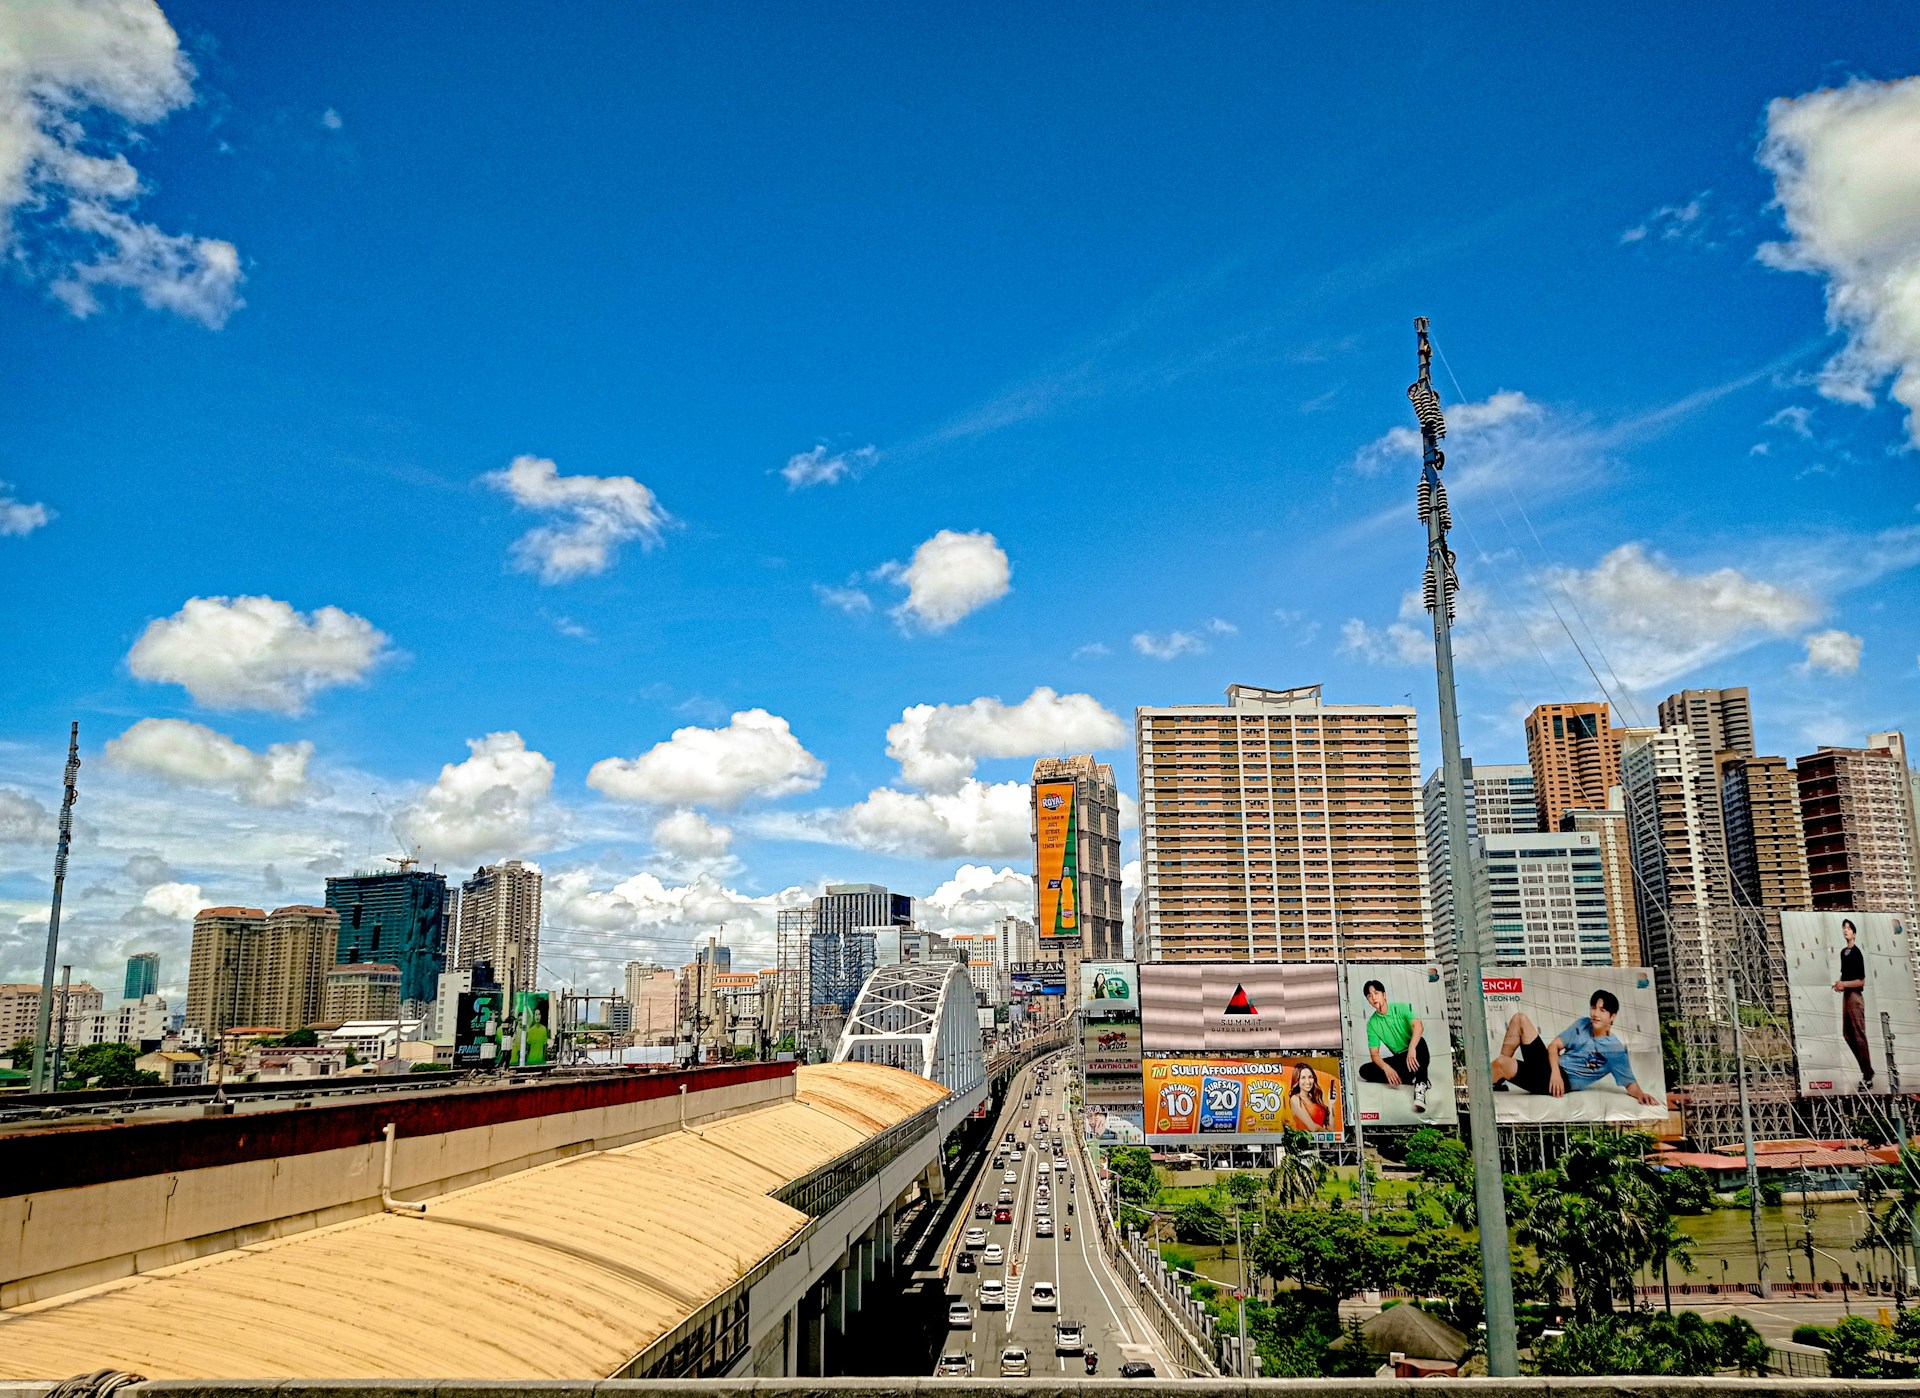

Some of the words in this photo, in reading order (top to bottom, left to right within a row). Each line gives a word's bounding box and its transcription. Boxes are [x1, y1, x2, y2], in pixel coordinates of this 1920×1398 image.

[1042, 796, 1064, 808] ROYAL
[1012, 962, 1064, 971] NISSAN
[1482, 981, 1518, 991] ENCH/
[1152, 1065, 1169, 1078] TNT
[1171, 1064, 1200, 1076] SULIT
[1160, 1083, 1197, 1098] PANTAWID
[1204, 1081, 1240, 1095] SURFSAYA
